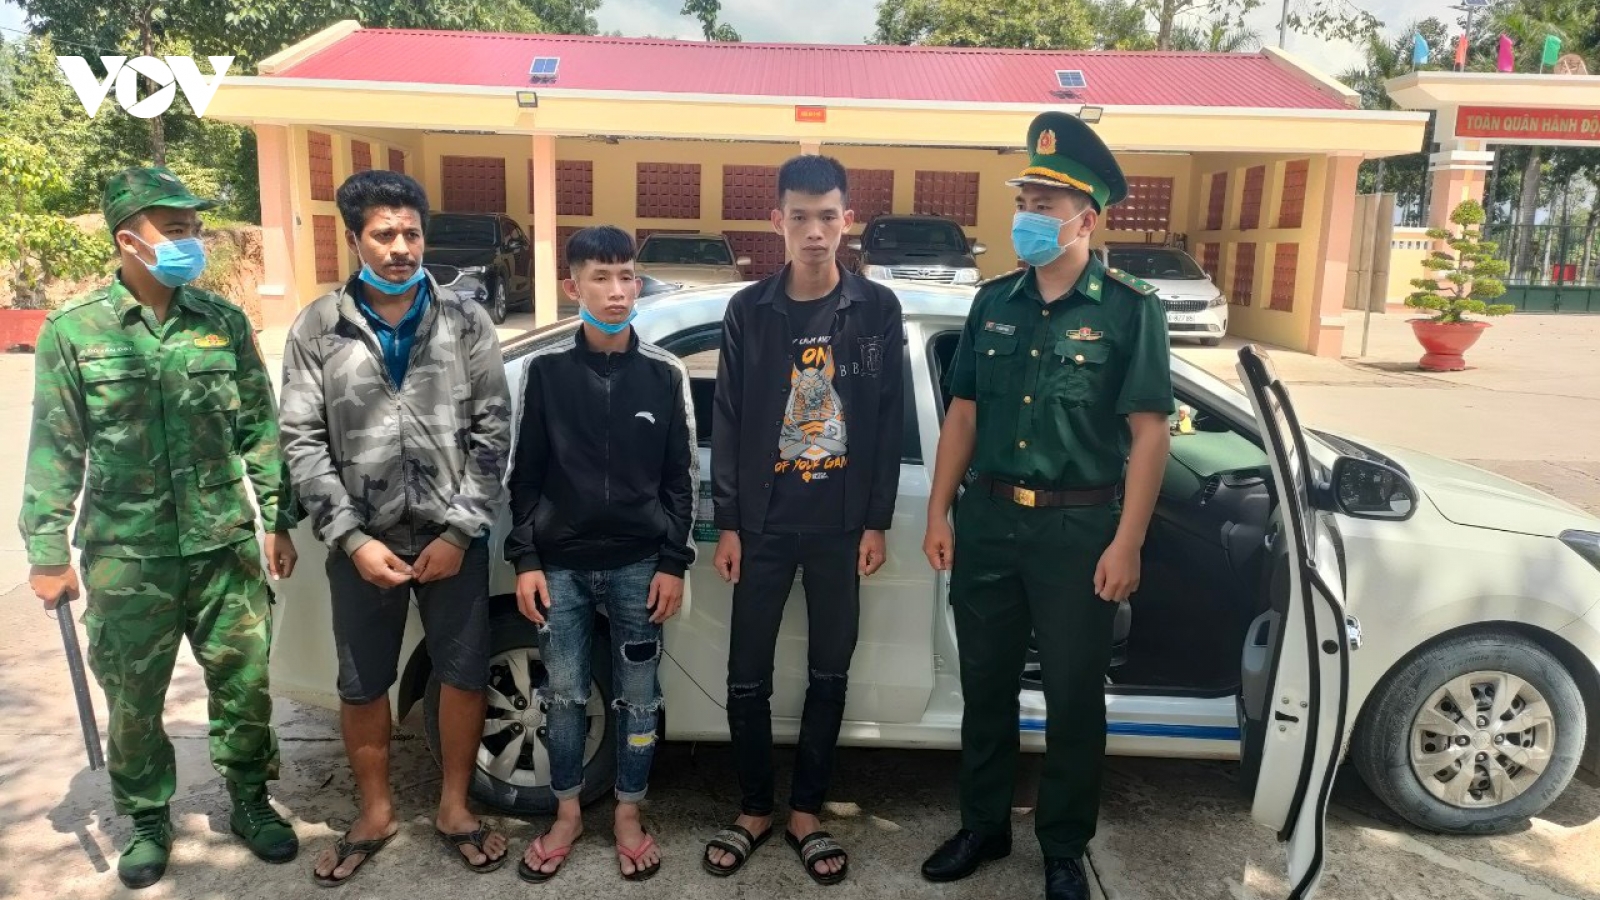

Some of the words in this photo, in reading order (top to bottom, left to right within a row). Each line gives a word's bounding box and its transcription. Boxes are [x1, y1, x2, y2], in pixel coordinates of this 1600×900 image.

[1466, 112, 1500, 131] TOÀN
[1503, 113, 1538, 132] QUÂN
[1542, 115, 1577, 132] HÀNH
[1580, 115, 1600, 137] ĐỘ
[774, 460, 790, 474] OF
[792, 458, 821, 472] YOUR
